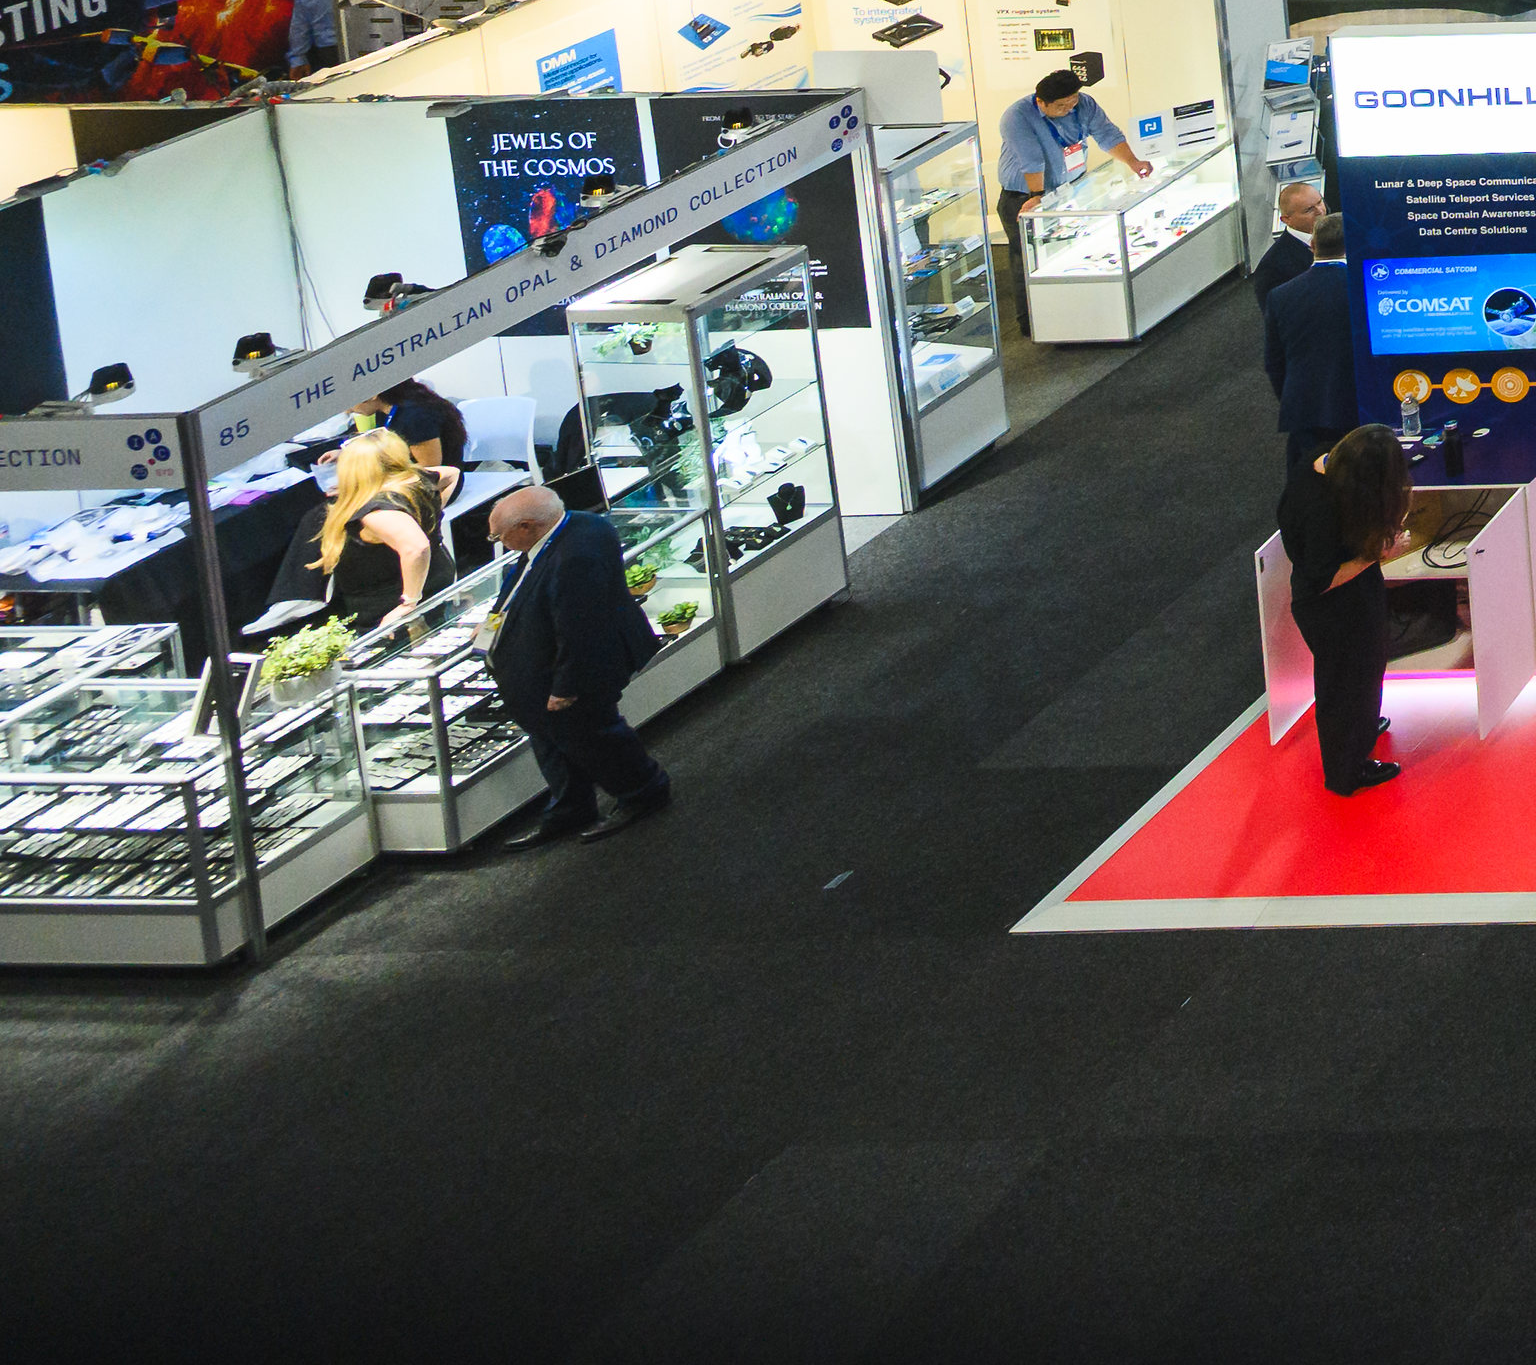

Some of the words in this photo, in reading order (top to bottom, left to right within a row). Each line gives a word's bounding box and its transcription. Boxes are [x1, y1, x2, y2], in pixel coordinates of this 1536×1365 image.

[540, 49, 577, 72] DMM
[492, 132, 564, 155] JEWELS
[568, 132, 597, 150] OF
[480, 161, 520, 177] THE
[524, 157, 616, 176] COSMOS
[1375, 180, 1404, 189] Lunar
[1407, 179, 1414, 188] &
[1417, 179, 1443, 189] Deep
[1445, 178, 1476, 188] Space
[1406, 195, 1446, 204] Satellite
[1449, 194, 1489, 204] Teleport
[1492, 193, 1535, 202] Services
[1407, 212, 1438, 222] Space
[1441, 211, 1479, 219] Domain
[1482, 210, 1536, 218] Awareness
[1419, 228, 1441, 236] Data
[1444, 227, 1478, 235] Centre
[1480, 226, 1527, 234] Solutions
[1395, 267, 1444, 276] COMMERCIAL
[1445, 266, 1477, 274] SATCOM
[219, 418, 251, 446] 85
[289, 376, 336, 410] THE
[351, 298, 493, 381] AUSTRALIAN
[506, 270, 557, 304] OPAL
[570, 255, 583, 272] &
[595, 207, 678, 259] DIAMOND
[689, 146, 798, 211] COLLECTION
[1395, 297, 1472, 313] COMSAT
